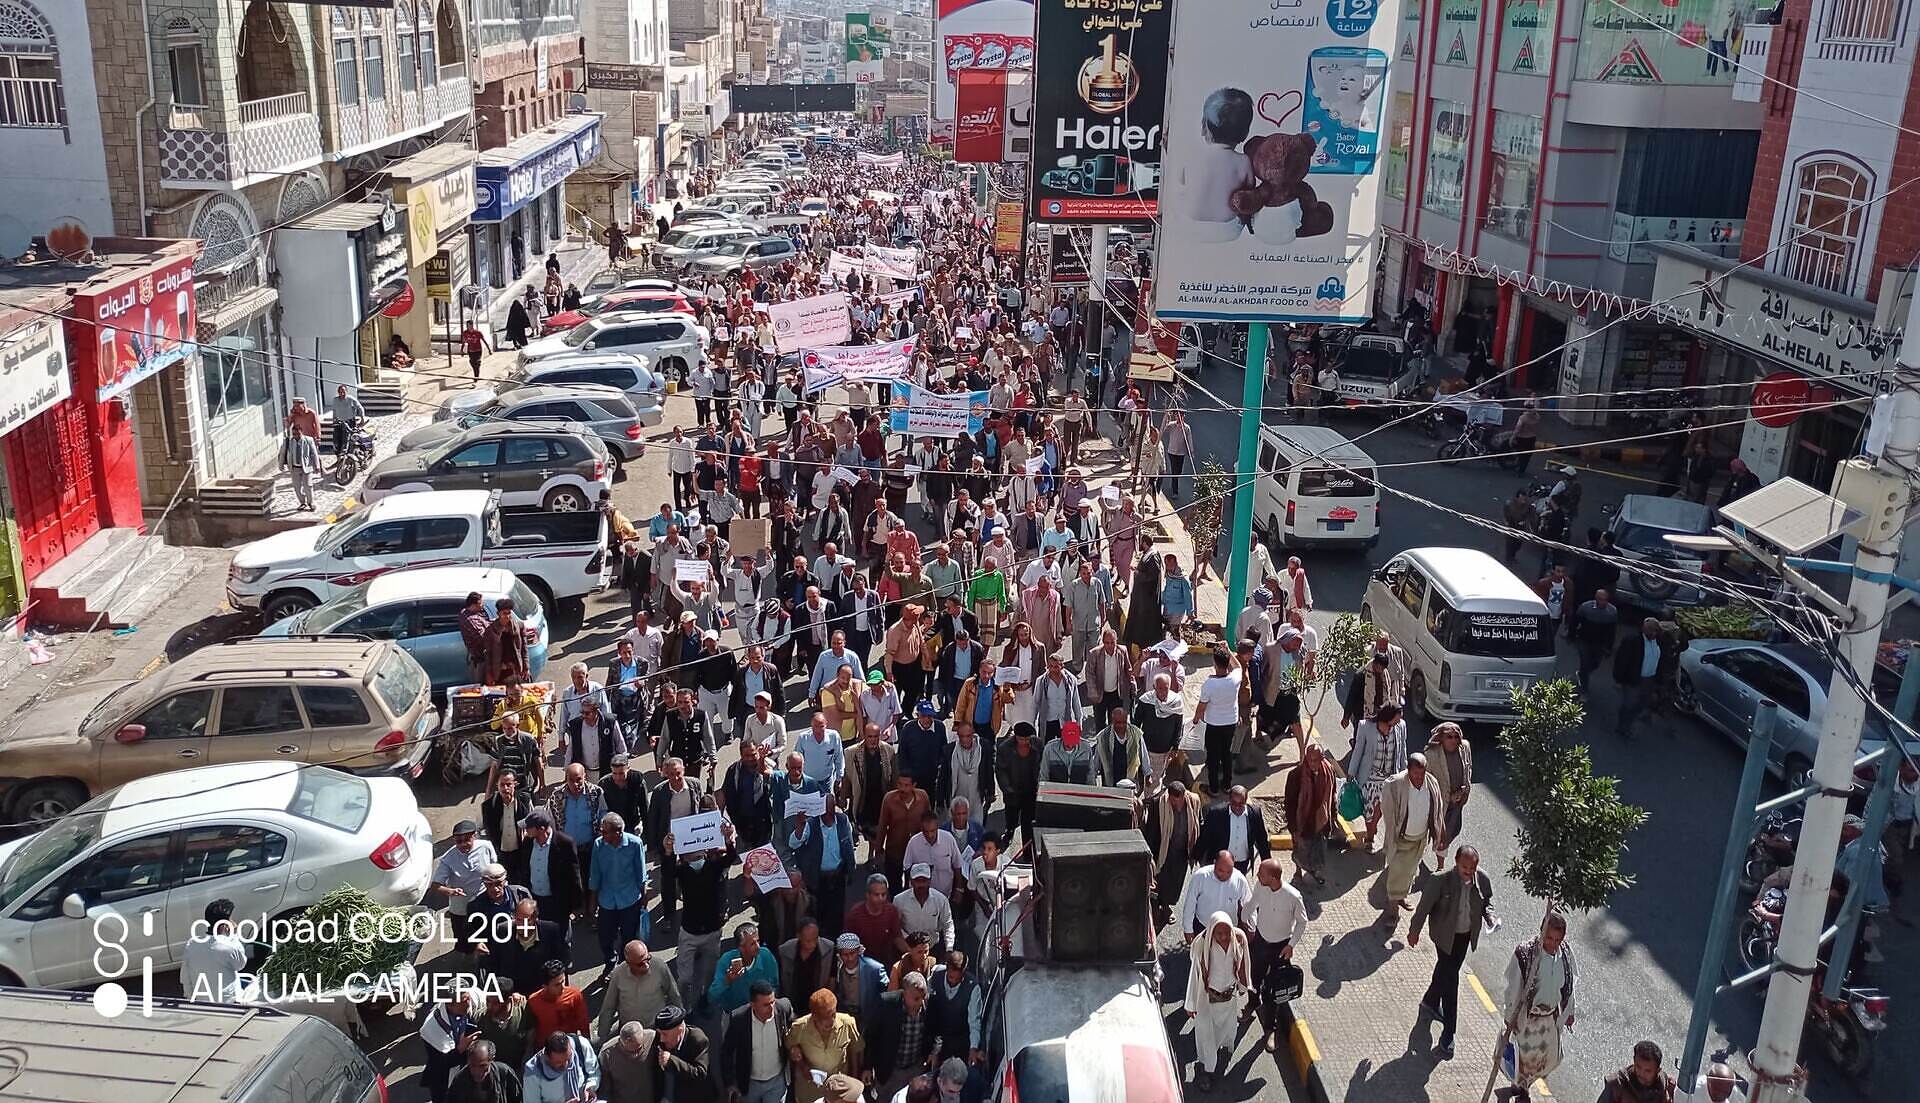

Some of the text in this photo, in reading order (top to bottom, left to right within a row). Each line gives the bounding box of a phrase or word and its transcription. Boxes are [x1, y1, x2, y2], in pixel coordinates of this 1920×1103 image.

[1335, 0, 1372, 20] 12
[1082, 14, 1120, 33] التوالي
[1250, 15, 1320, 29] الامتصاص
[1336, 22, 1366, 32] ساعة
[948, 52, 975, 66] Crystal
[977, 51, 1006, 67] Crystal
[1056, 116, 1161, 150] Haier
[1336, 133, 1356, 143] Baby
[1335, 142, 1370, 155] Royal
[509, 167, 534, 206] Haier
[1281, 287, 1312, 298] شركة
[1178, 296, 1309, 307] AL-MAWJ AL-AKHDAR FOOD CO
[2, 330, 54, 377] استديو
[1761, 332, 1835, 374] AL-HELAL
[1340, 384, 1375, 395] UZUKI
[692, 722, 701, 734] S
